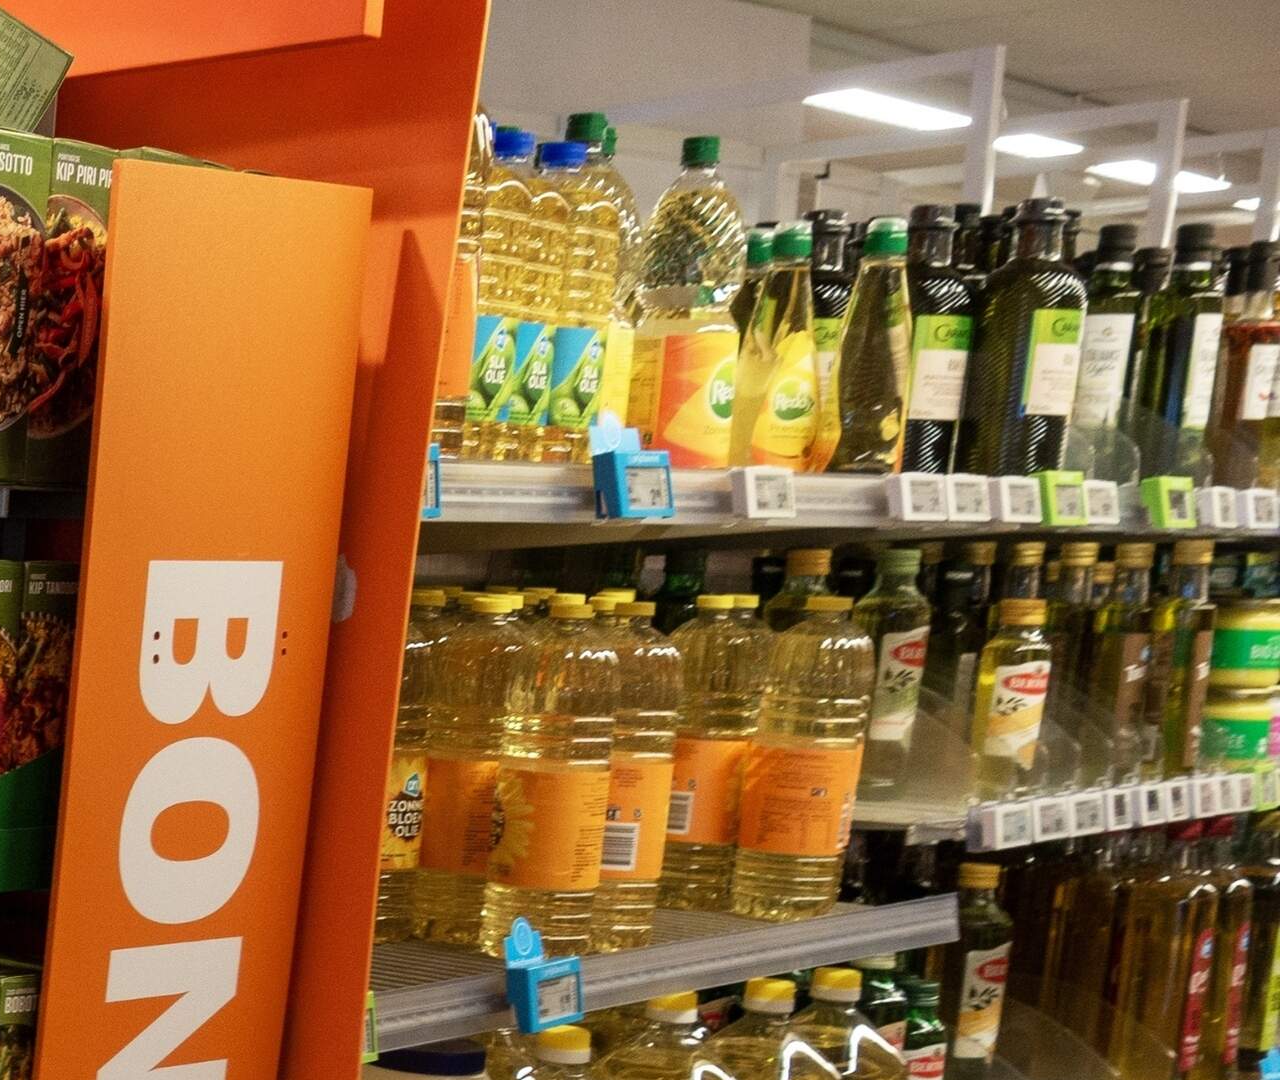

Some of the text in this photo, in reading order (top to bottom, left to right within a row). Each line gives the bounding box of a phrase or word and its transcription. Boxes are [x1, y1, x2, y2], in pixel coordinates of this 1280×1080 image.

[16, 288, 28, 339] OPEN HIER
[489, 355, 506, 372] SLA
[533, 361, 547, 377] SLA
[484, 369, 507, 385] OLIE
[583, 364, 598, 380] SLA
[527, 375, 549, 391] OLIE
[578, 377, 600, 394] OLIE
[396, 824, 420, 839] OLIE
